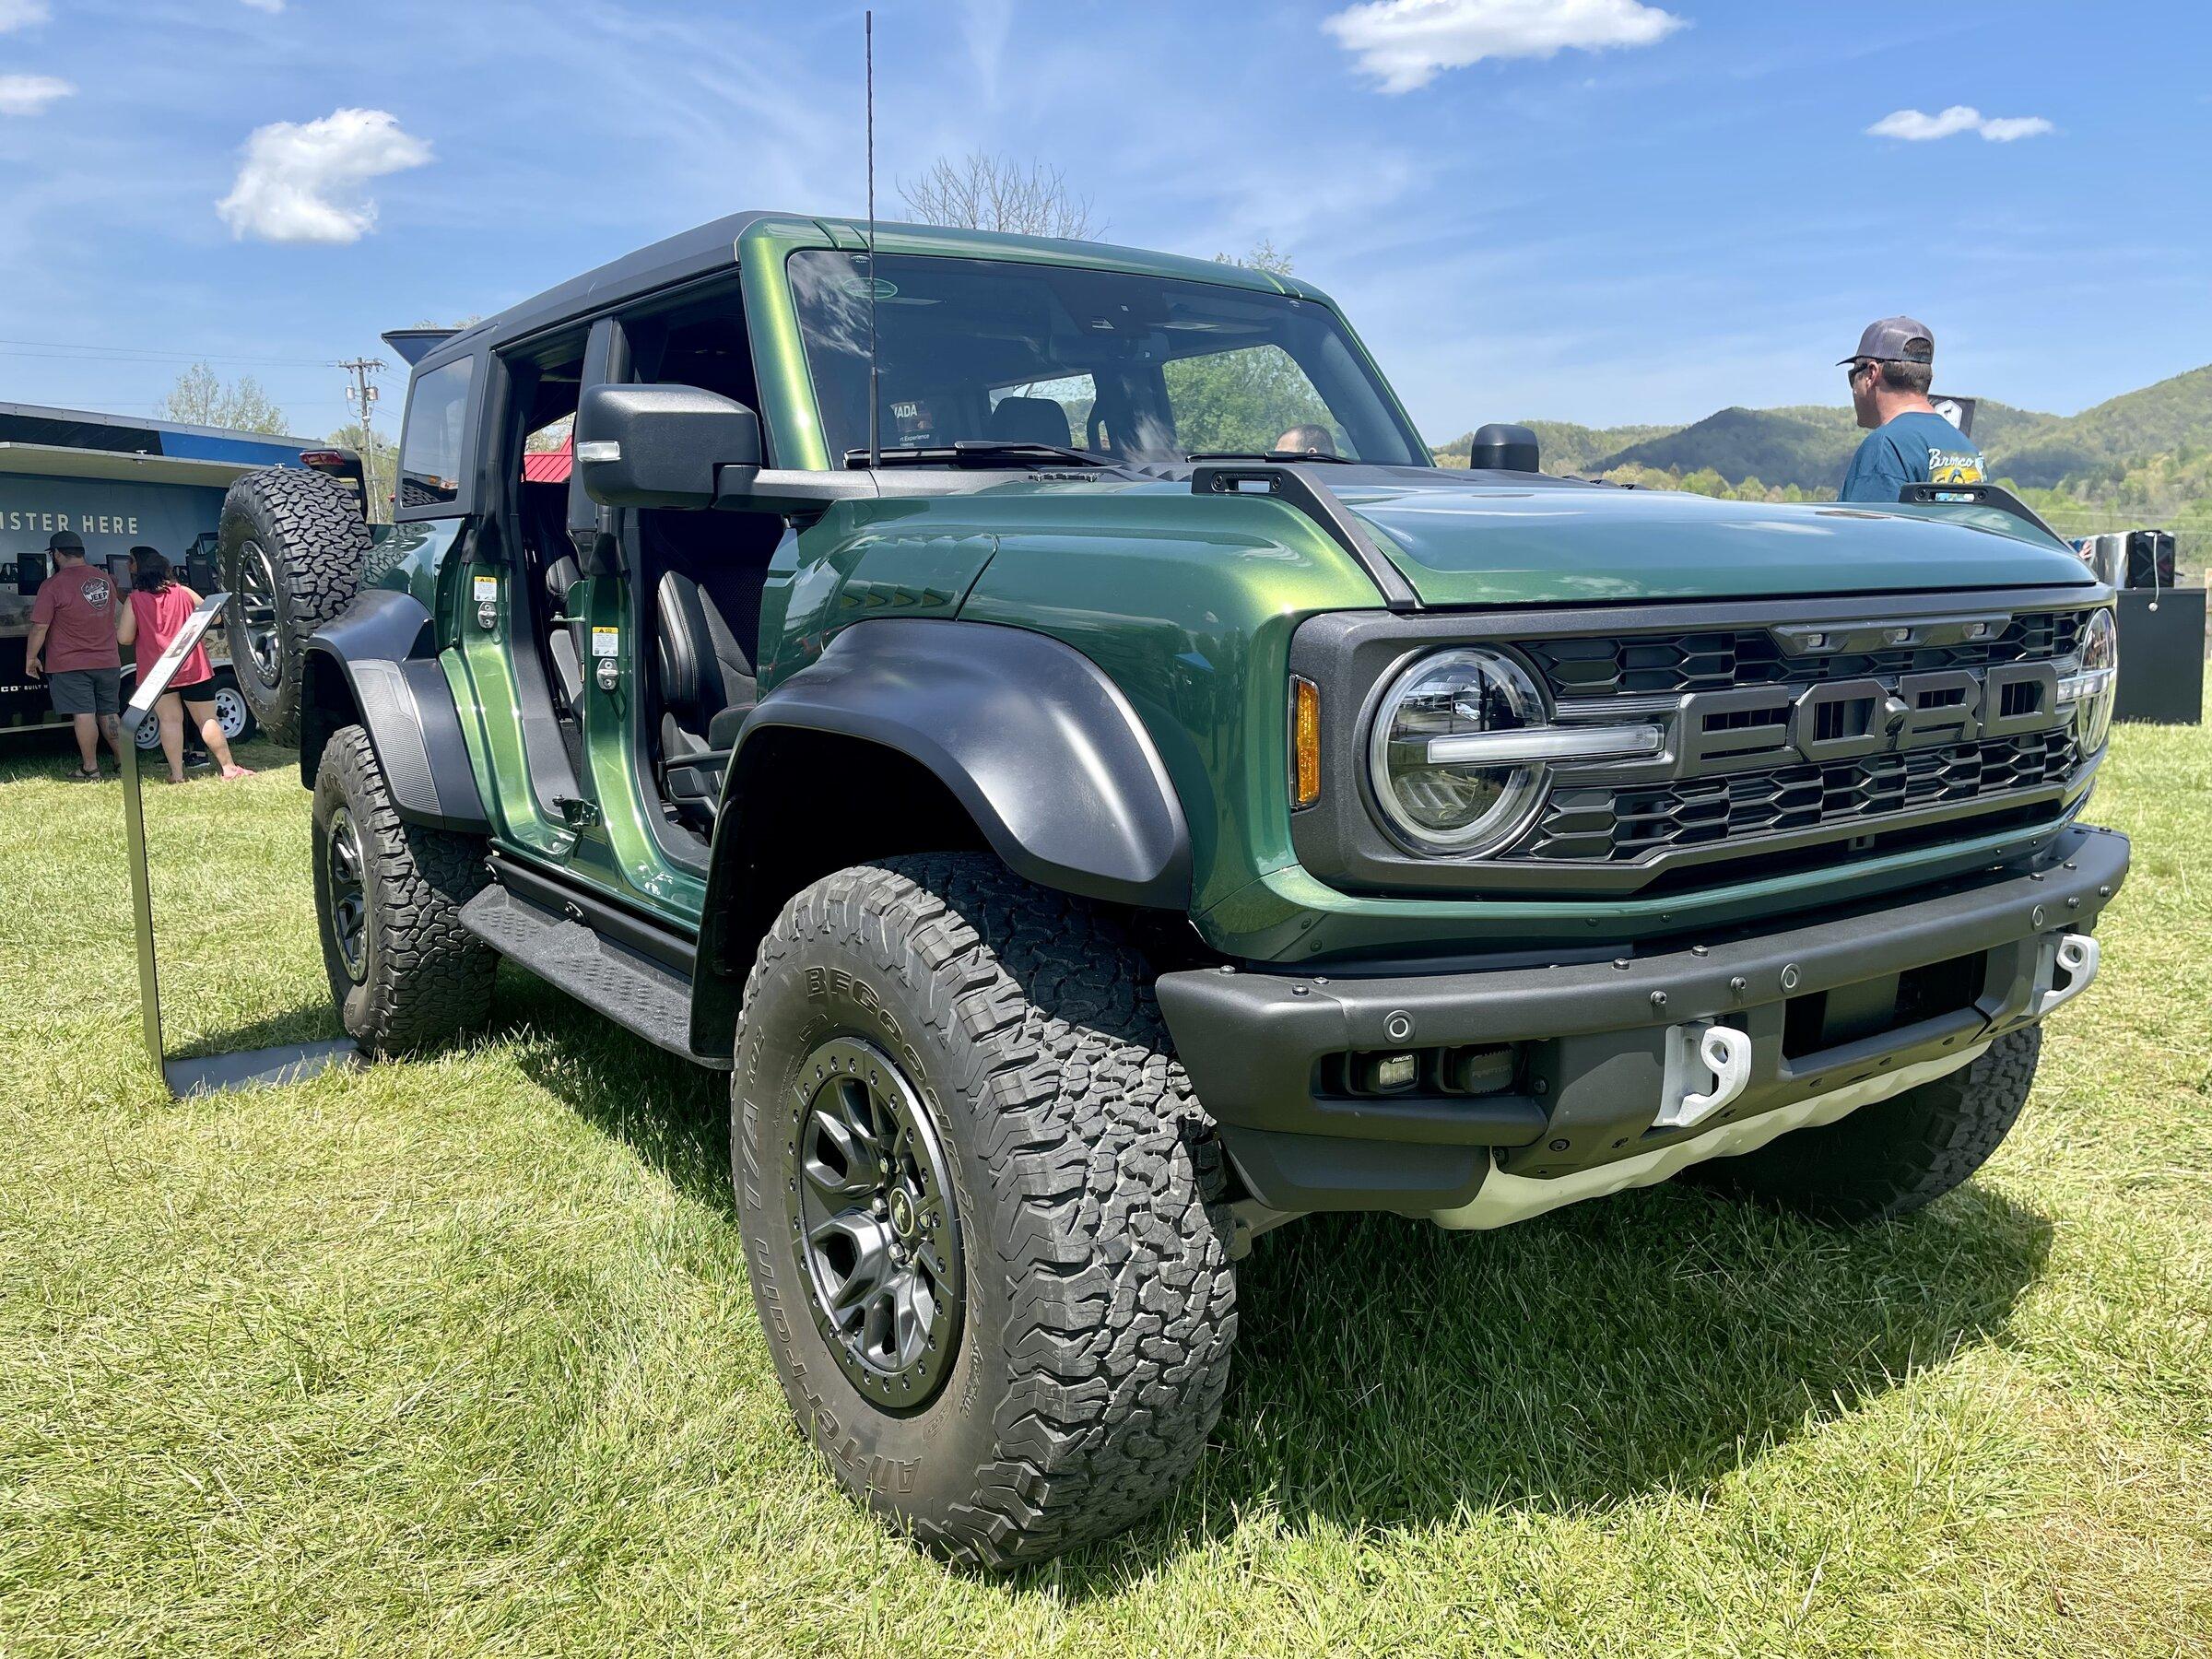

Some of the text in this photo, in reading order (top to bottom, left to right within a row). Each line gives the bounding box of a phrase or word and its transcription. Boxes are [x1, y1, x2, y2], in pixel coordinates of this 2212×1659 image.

[1928, 448, 1974, 470] Bronco
[82, 514, 138, 535] HERE
[90, 592, 108, 602] JEEP
[1676, 661, 2057, 781] FORD
[741, 1098, 762, 1211] T/A
